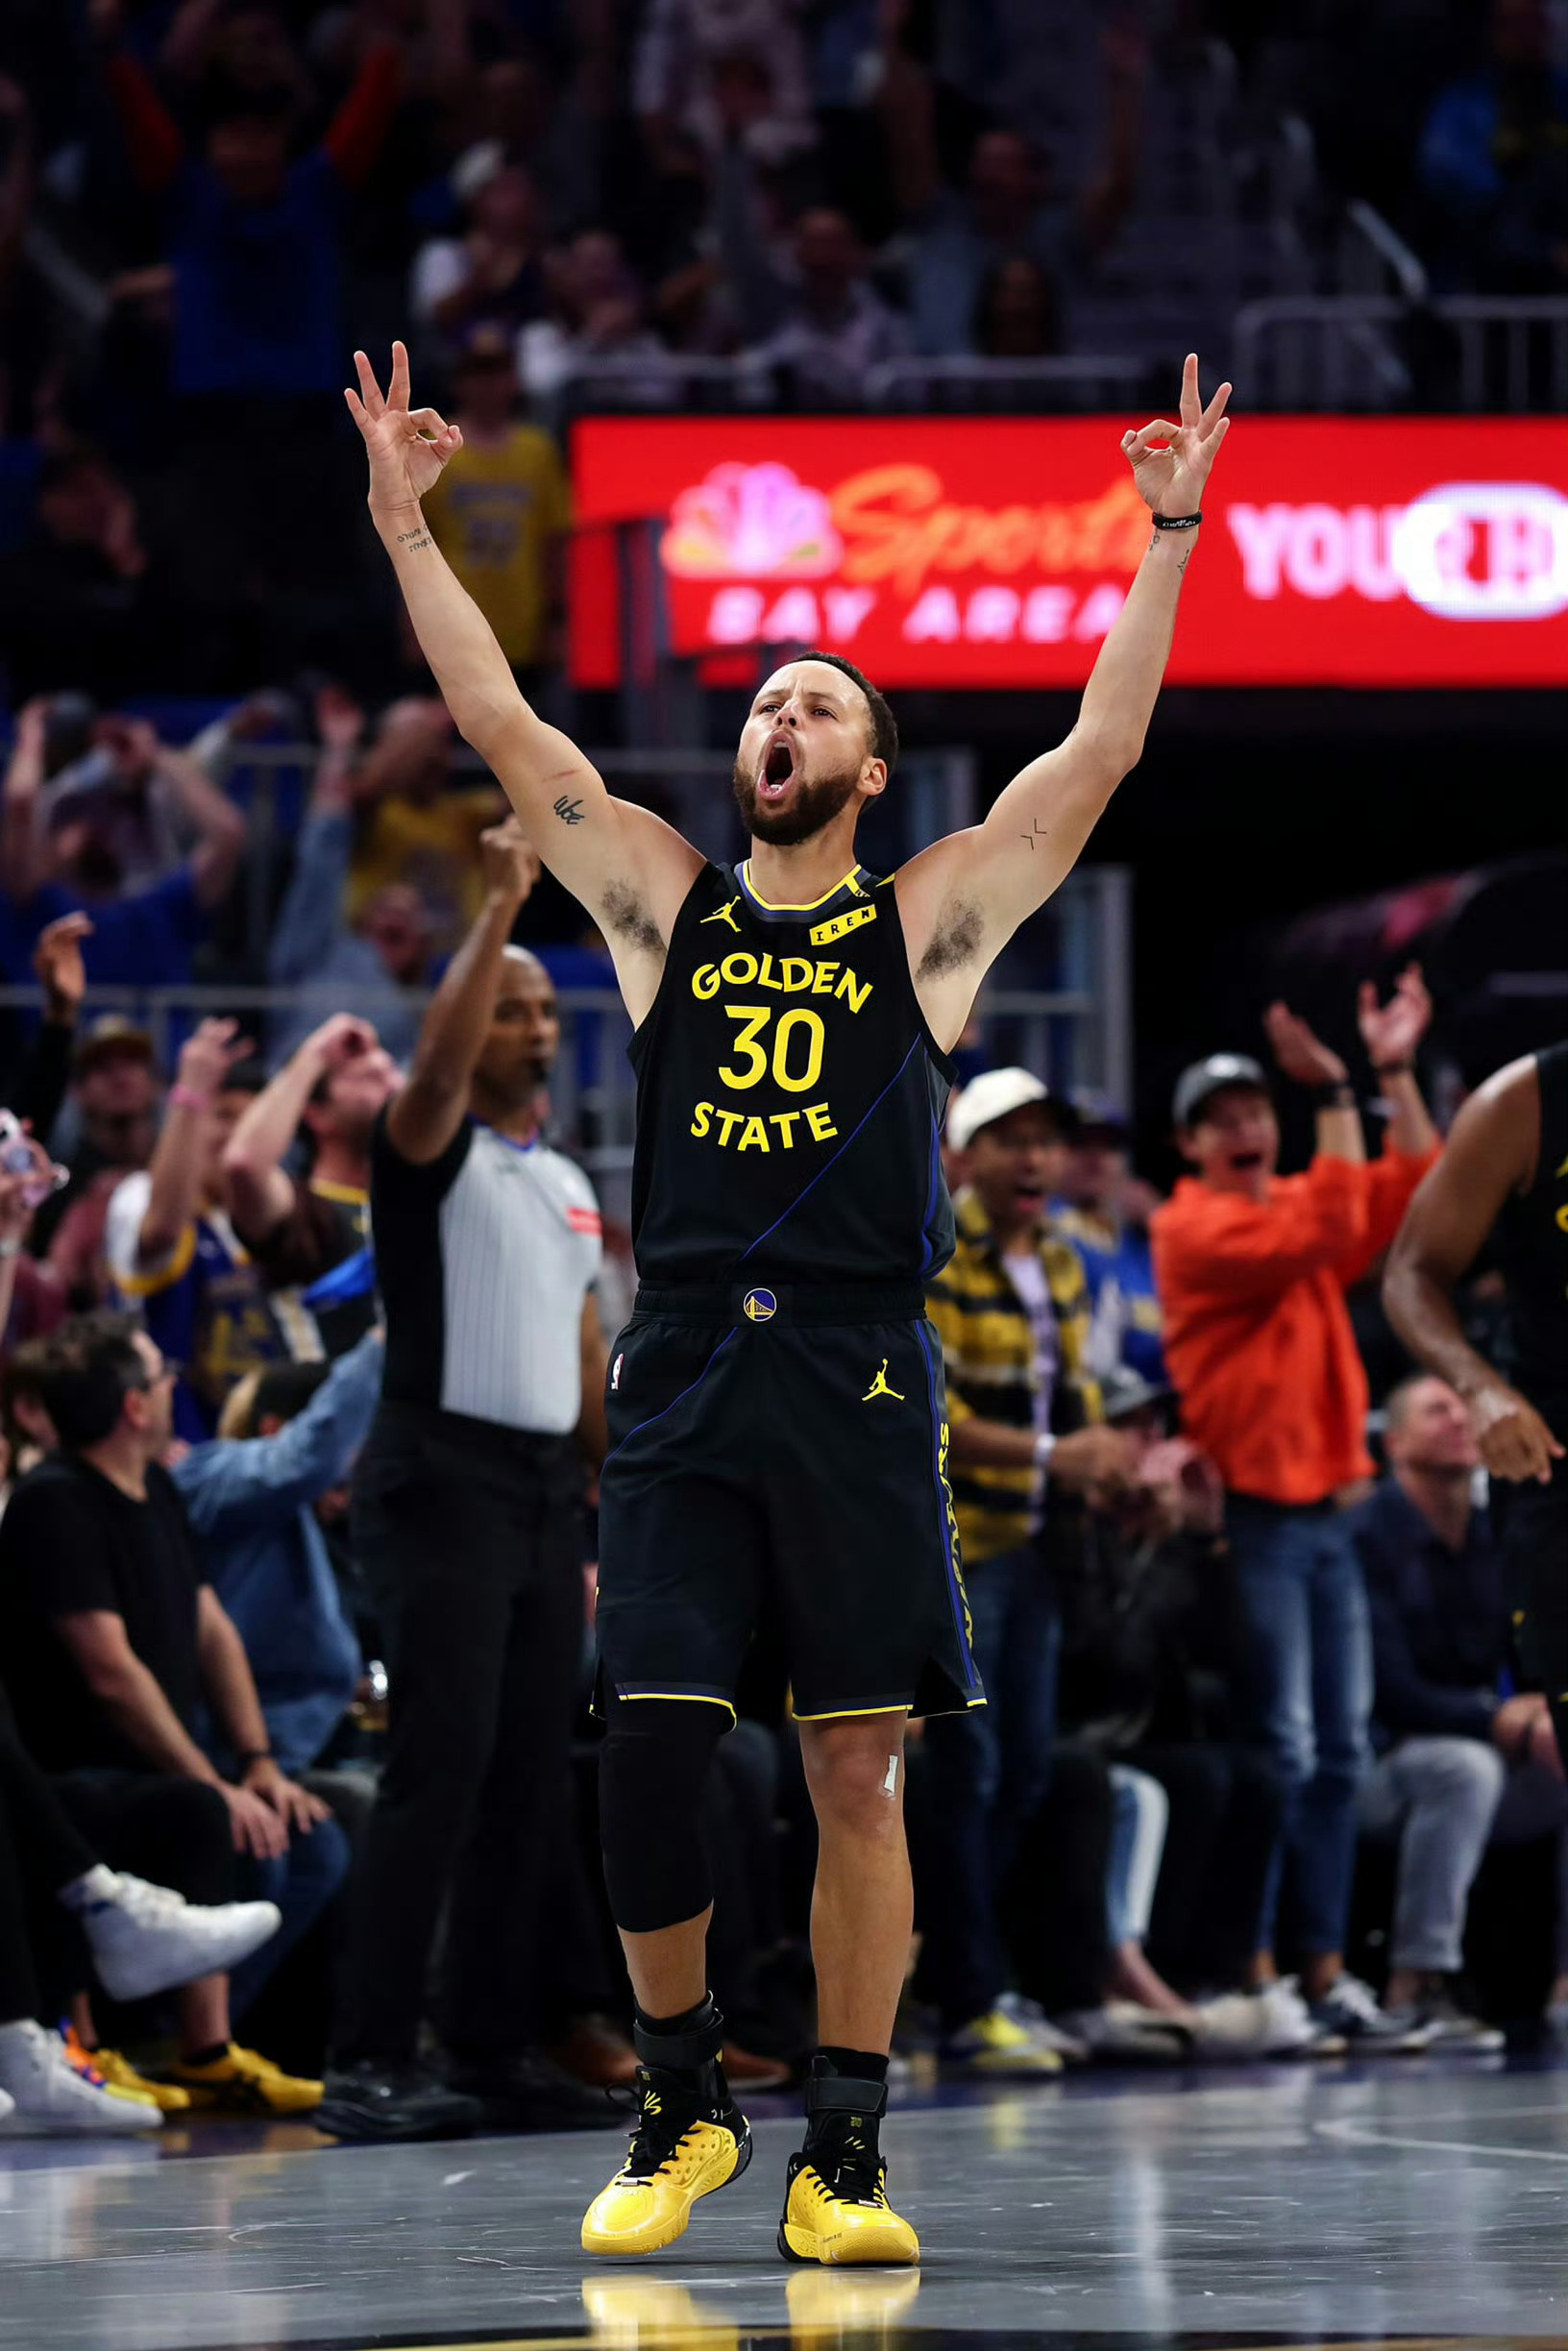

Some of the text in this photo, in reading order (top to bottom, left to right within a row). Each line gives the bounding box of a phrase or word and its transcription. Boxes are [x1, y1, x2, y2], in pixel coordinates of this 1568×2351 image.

[830, 461, 1152, 599] Sport
[706, 584, 1131, 644] BAY AREA
[816, 907, 871, 943] IREN
[691, 951, 873, 1015] GOLDEN
[718, 1004, 825, 1092] 30
[690, 1101, 839, 1153] STATE
